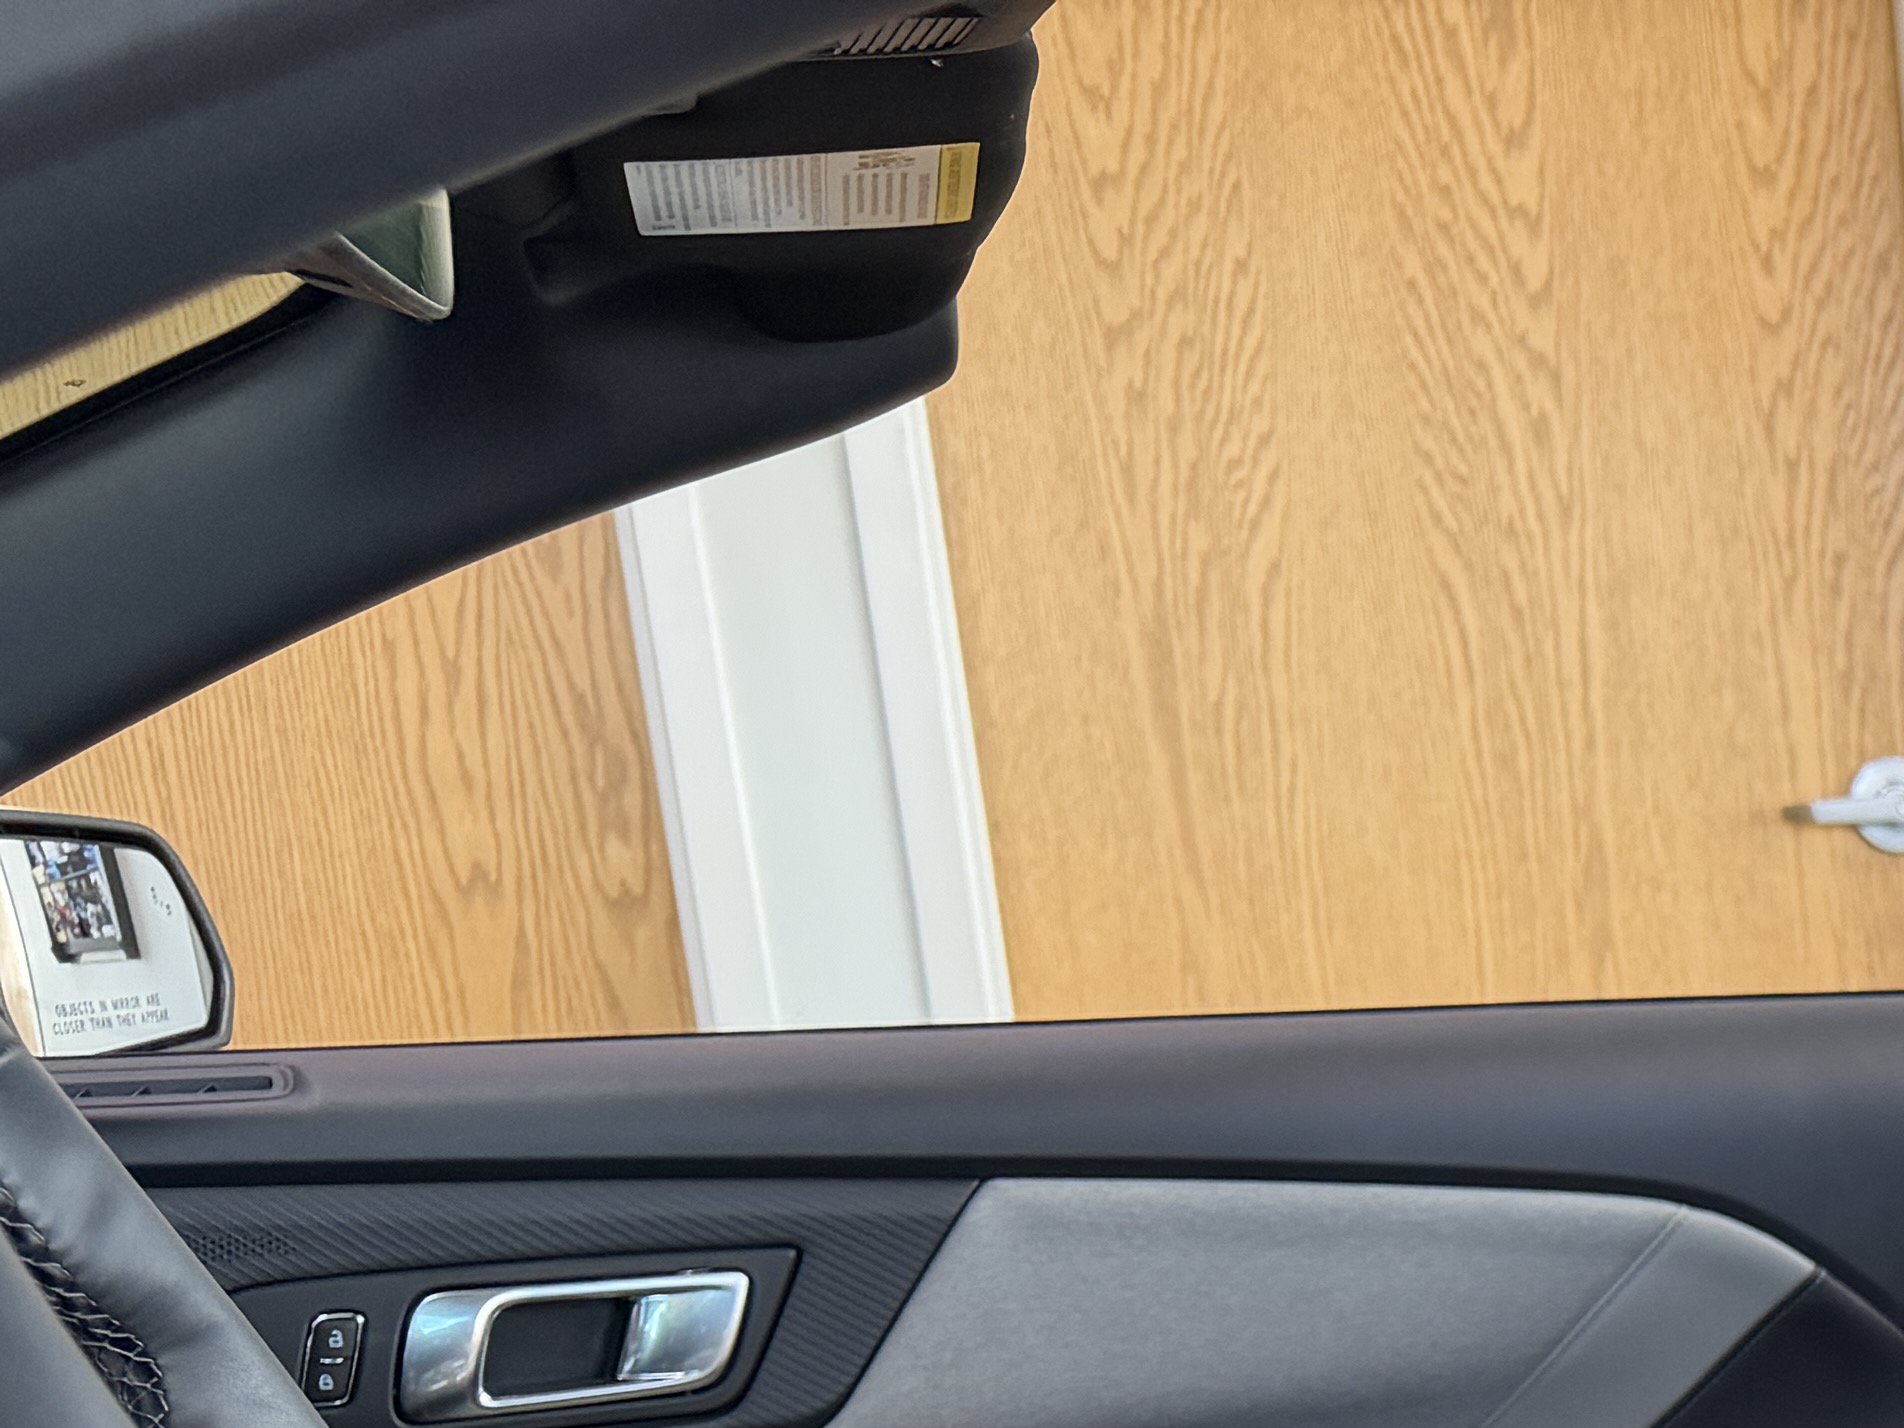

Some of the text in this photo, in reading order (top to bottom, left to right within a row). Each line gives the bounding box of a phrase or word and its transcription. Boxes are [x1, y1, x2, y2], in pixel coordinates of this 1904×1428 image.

[55, 993, 160, 1017] OBJECTS IN MIRROR ARE
[53, 1008, 169, 1035] CLOSER THAN THEY APPEAR
